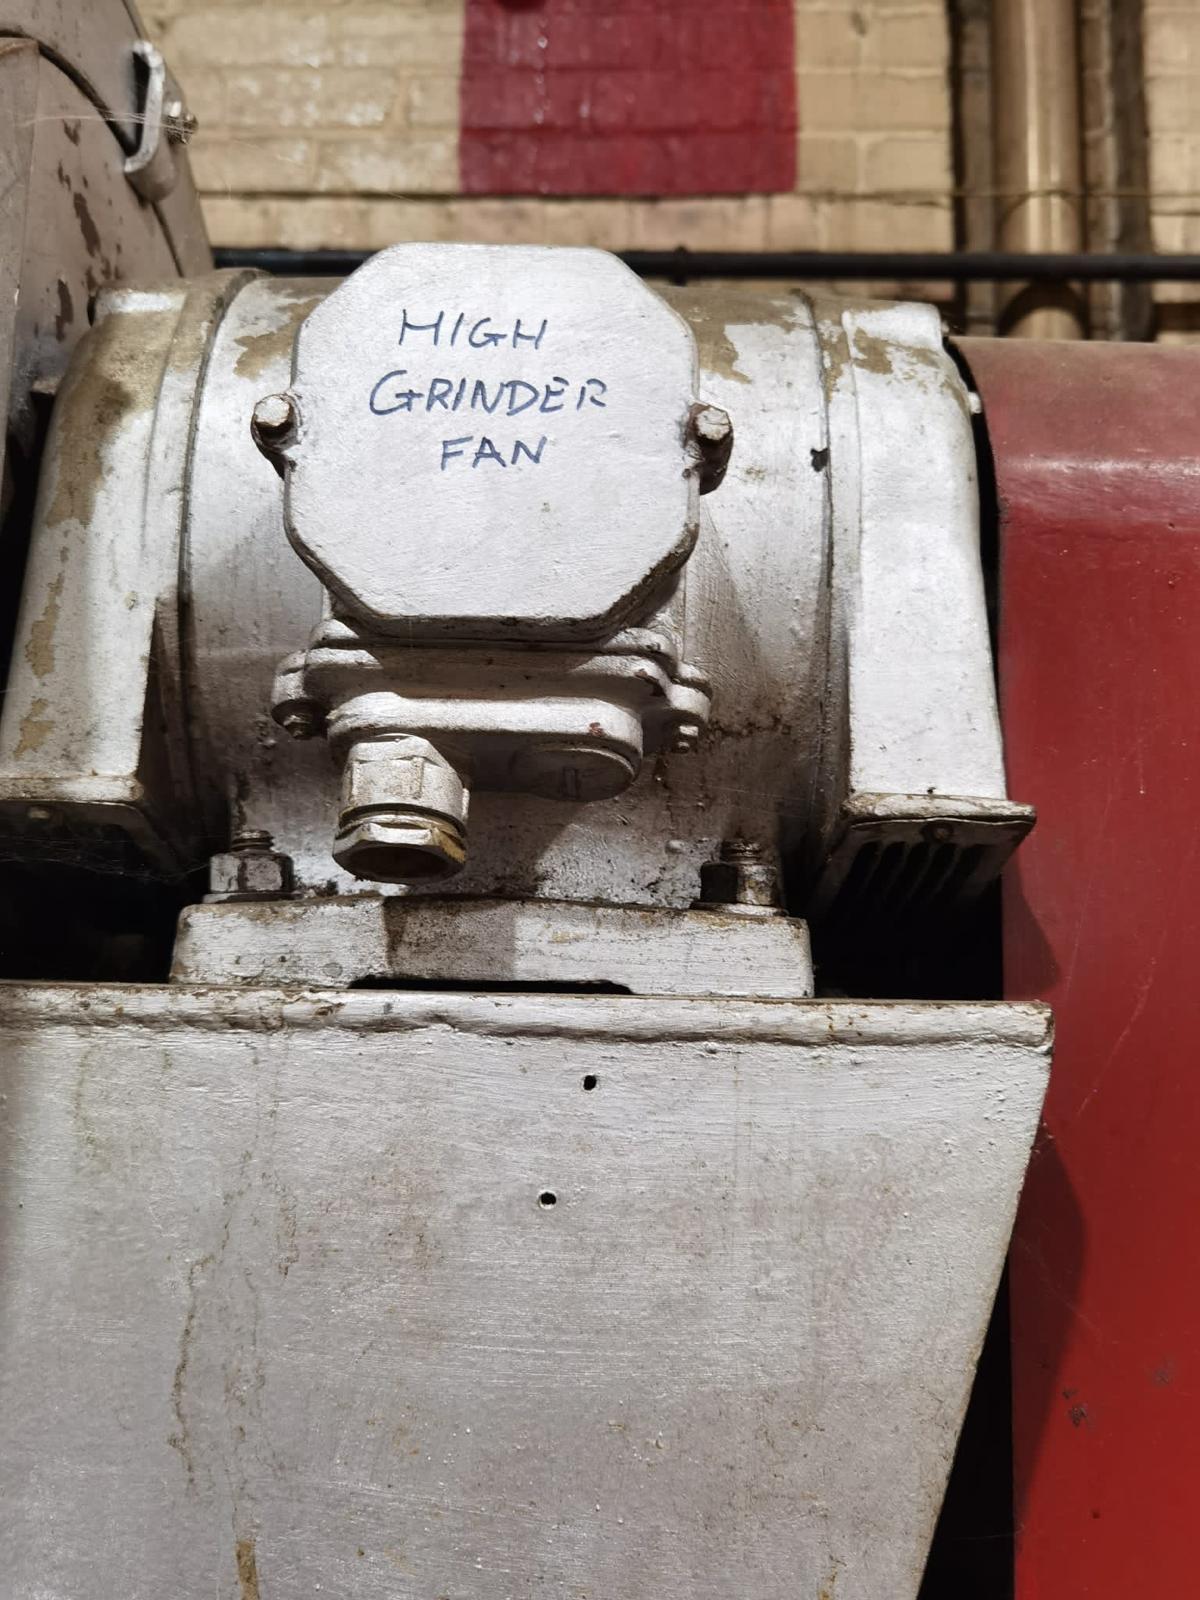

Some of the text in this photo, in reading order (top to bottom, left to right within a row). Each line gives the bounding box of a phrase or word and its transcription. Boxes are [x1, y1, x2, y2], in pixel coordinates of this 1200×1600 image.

[398, 308, 548, 350] HIGH
[368, 369, 607, 416] GRINDER
[440, 435, 548, 471] FAN
